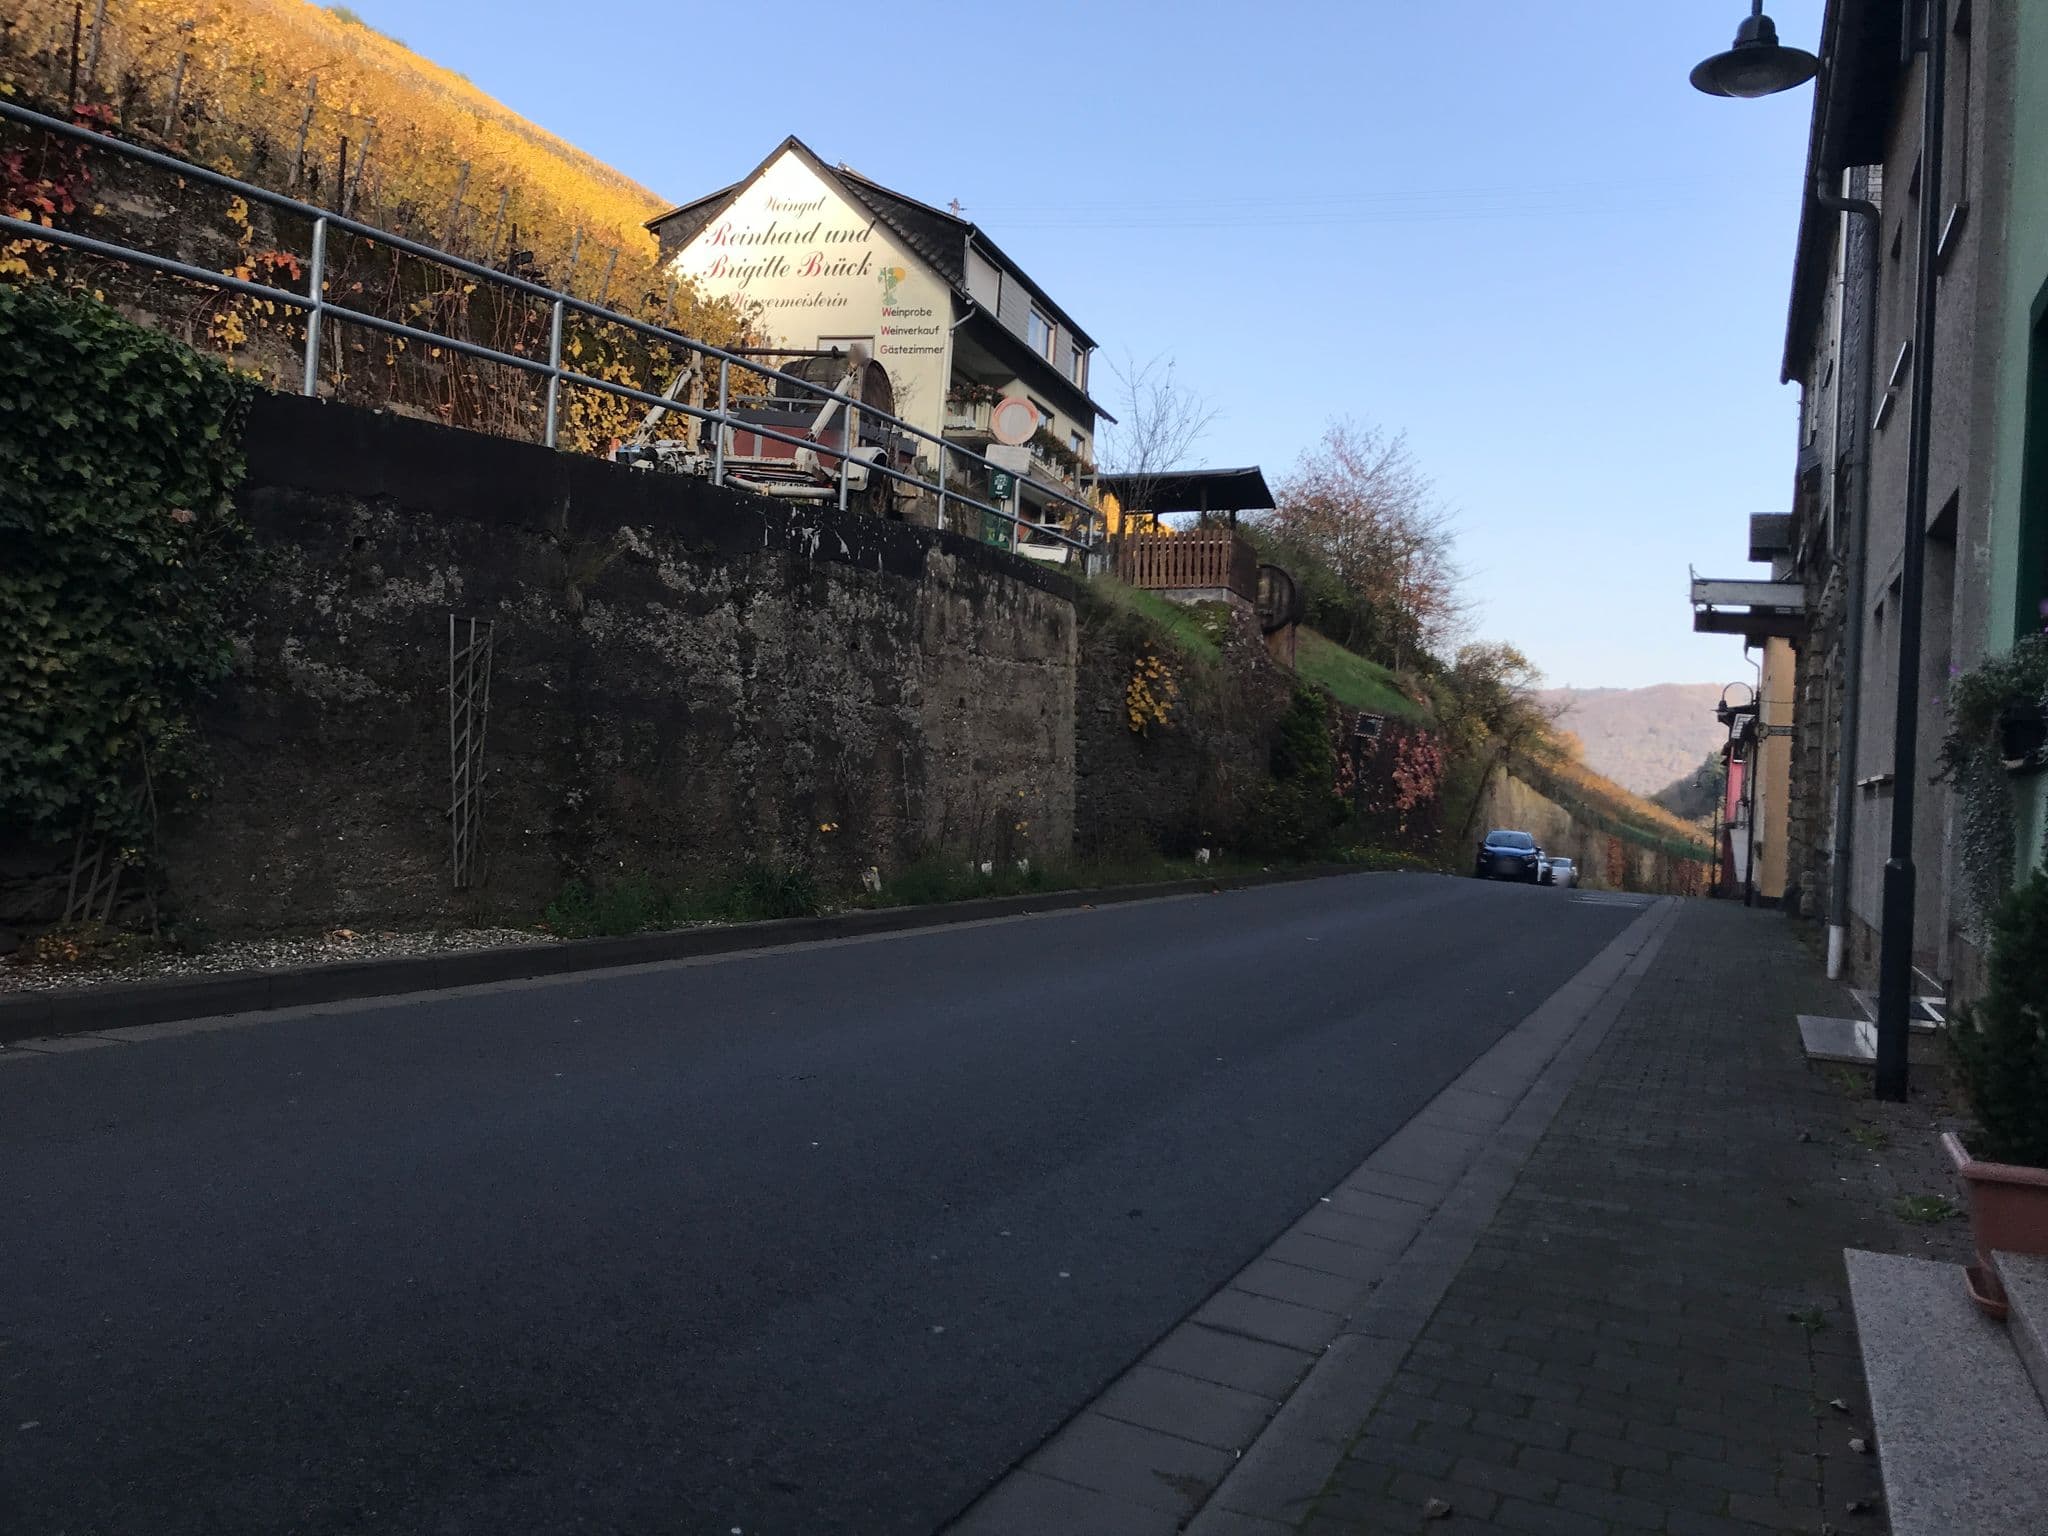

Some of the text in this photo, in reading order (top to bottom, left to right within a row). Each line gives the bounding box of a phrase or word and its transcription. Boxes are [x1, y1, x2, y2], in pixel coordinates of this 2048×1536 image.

[704, 219, 877, 246] Reinhard und
[702, 250, 873, 289] Brigitte Brück
[729, 291, 849, 308] Winermeisterin
[881, 306, 933, 318] Weinprobe
[880, 325, 940, 336] Weinverkauf
[879, 344, 945, 355] Gästezimmer
